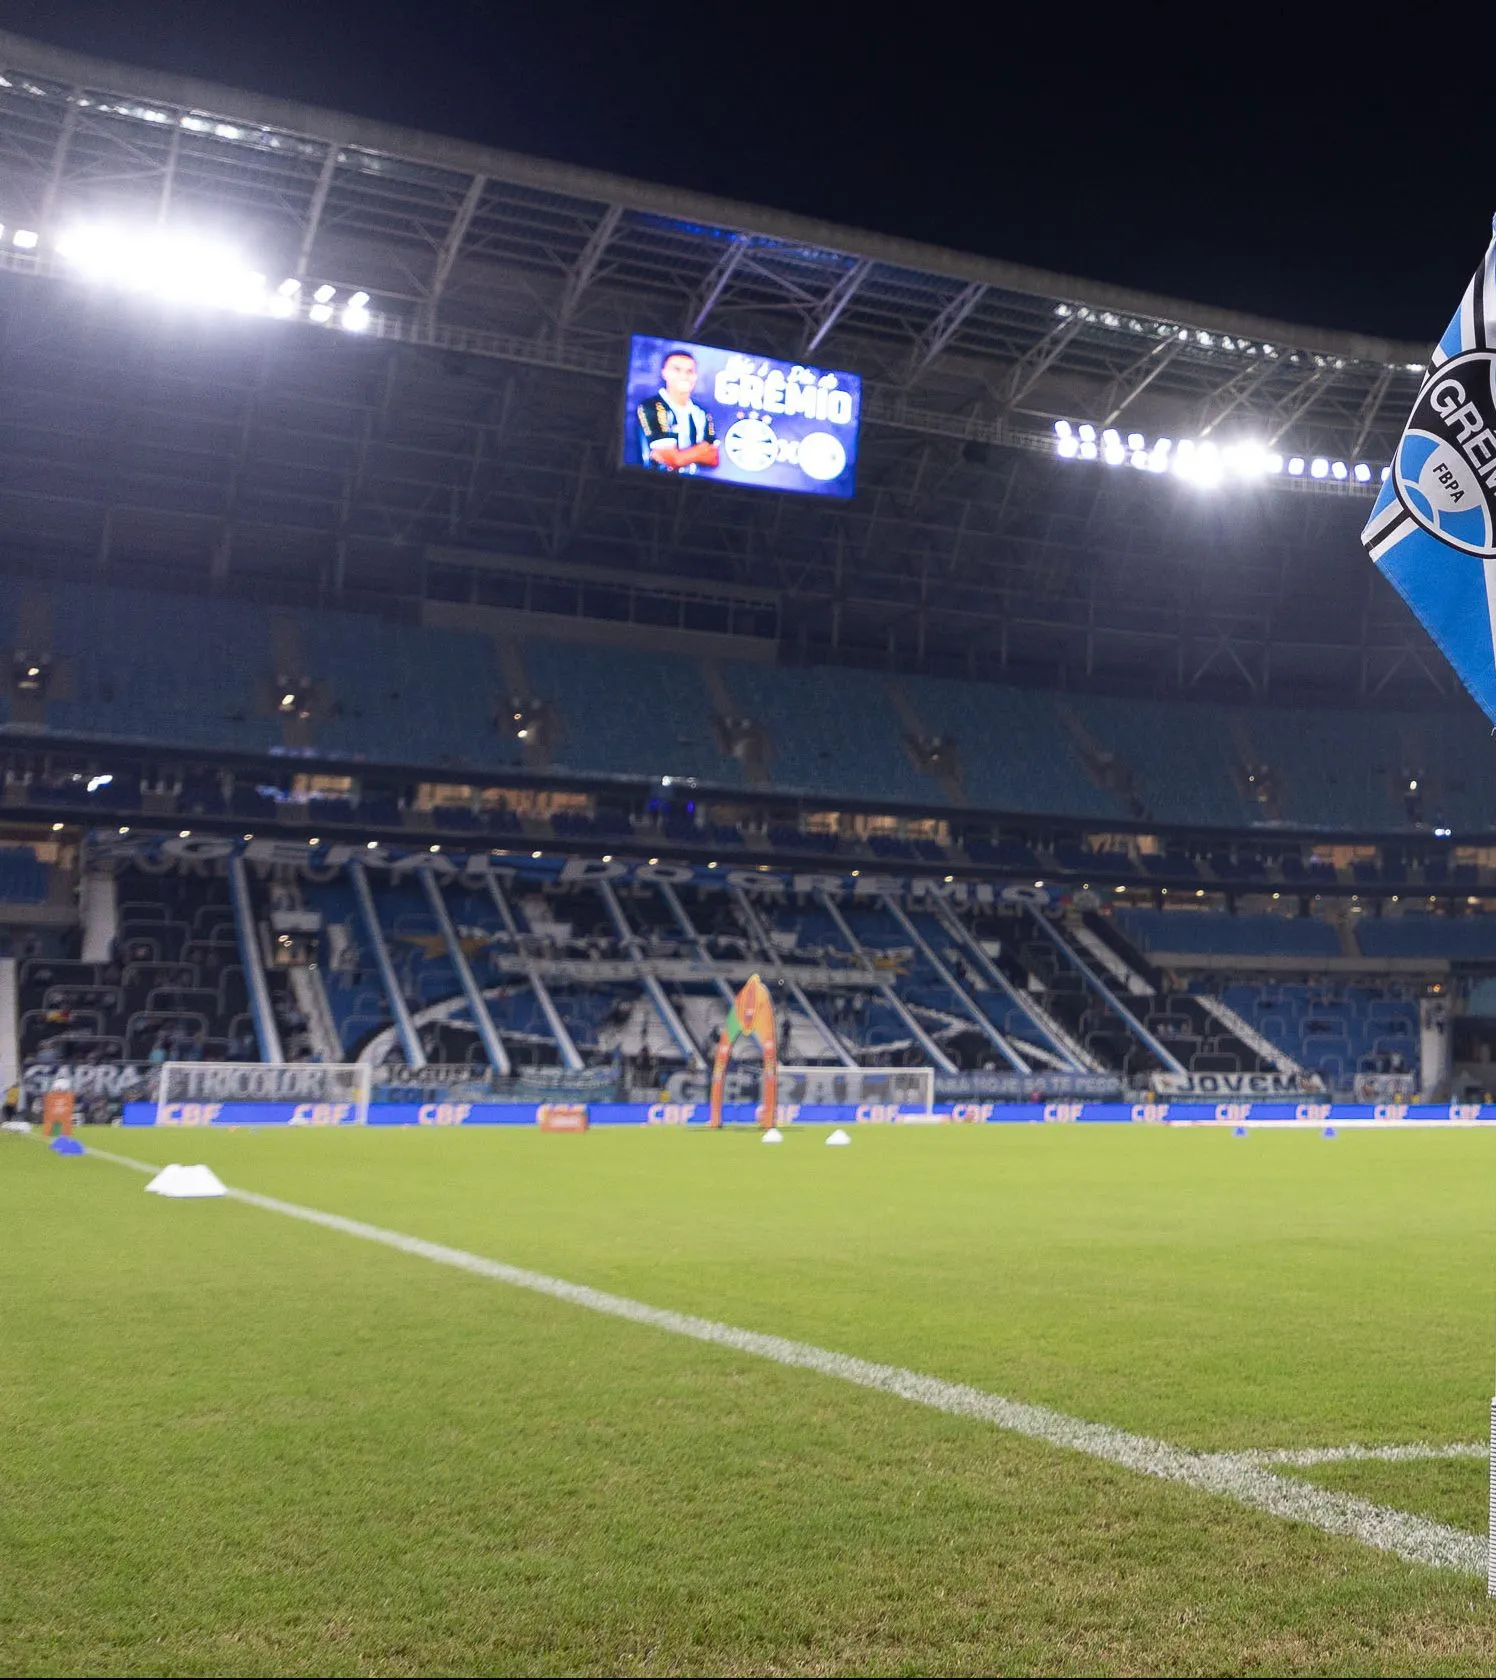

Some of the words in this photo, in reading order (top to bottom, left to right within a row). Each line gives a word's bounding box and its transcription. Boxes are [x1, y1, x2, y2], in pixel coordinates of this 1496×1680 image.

[1432, 462, 1465, 503] FBPA
[186, 1068, 323, 1098] TRICOLOR
[1185, 1074, 1301, 1093] JOVEM
[163, 1103, 224, 1124] CBF
[294, 1103, 350, 1124] CBF
[418, 1103, 471, 1124] CBF
[647, 1103, 697, 1124] CBF
